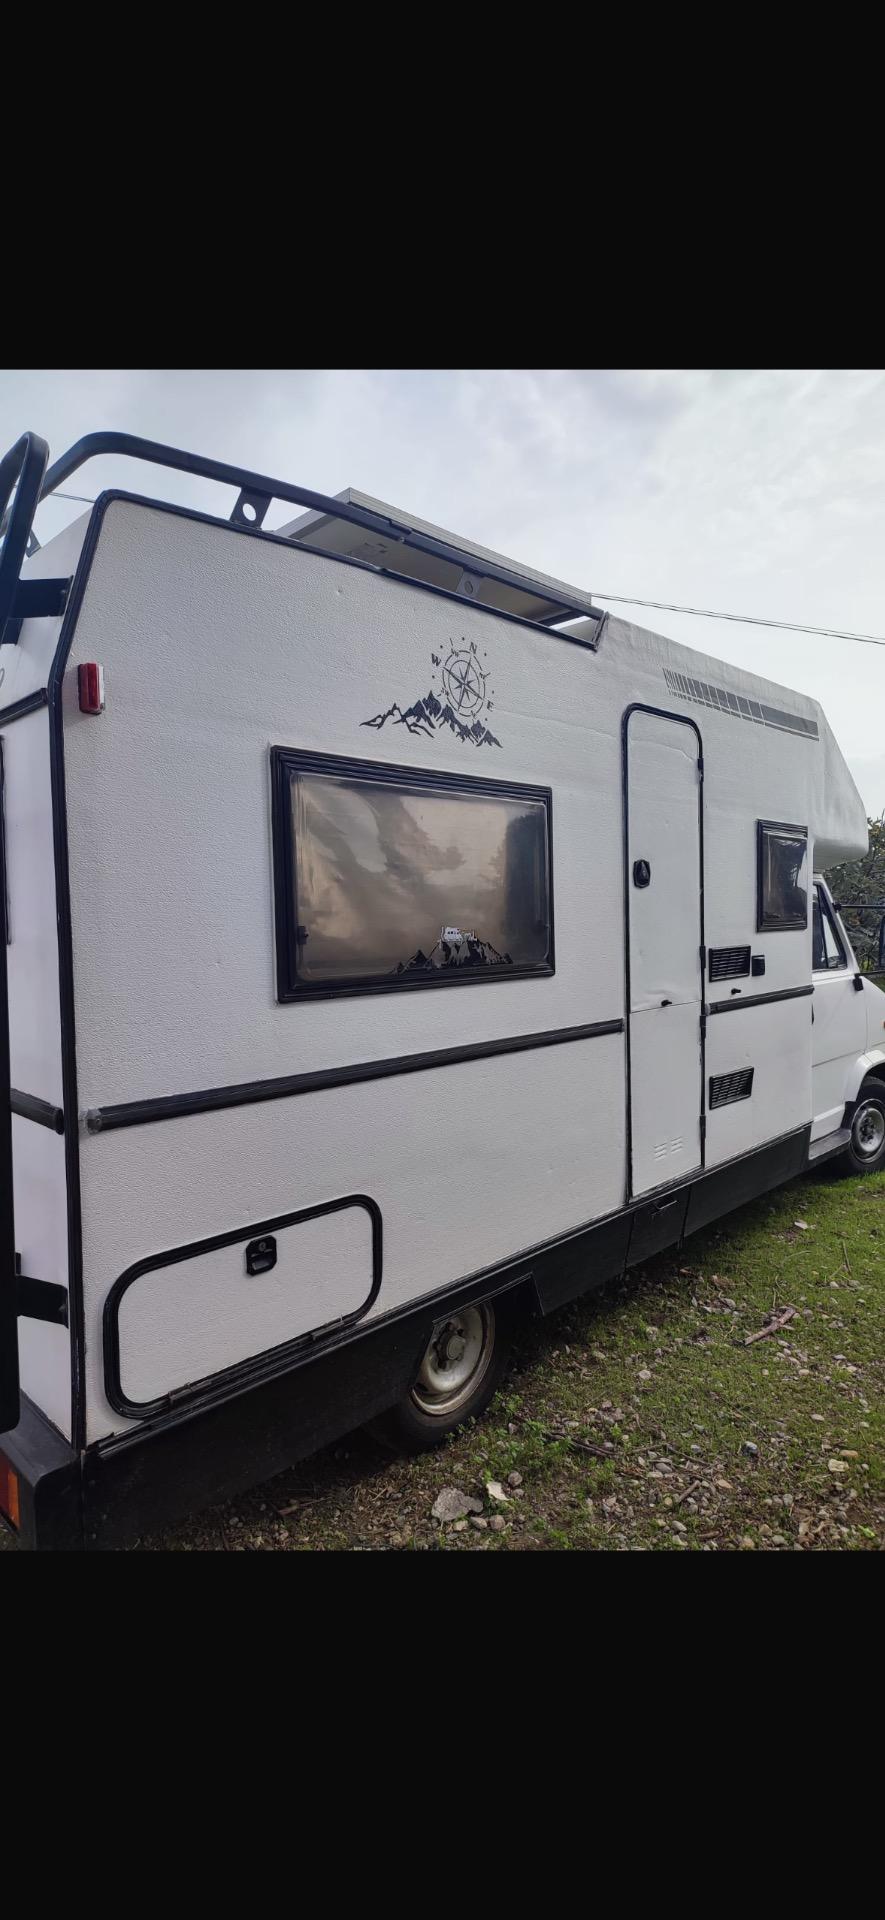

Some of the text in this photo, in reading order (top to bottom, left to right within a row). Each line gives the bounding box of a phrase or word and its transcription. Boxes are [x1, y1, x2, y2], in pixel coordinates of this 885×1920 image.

[469, 641, 478, 654] N
[431, 653, 441, 667] W
[487, 700, 495, 712] E
